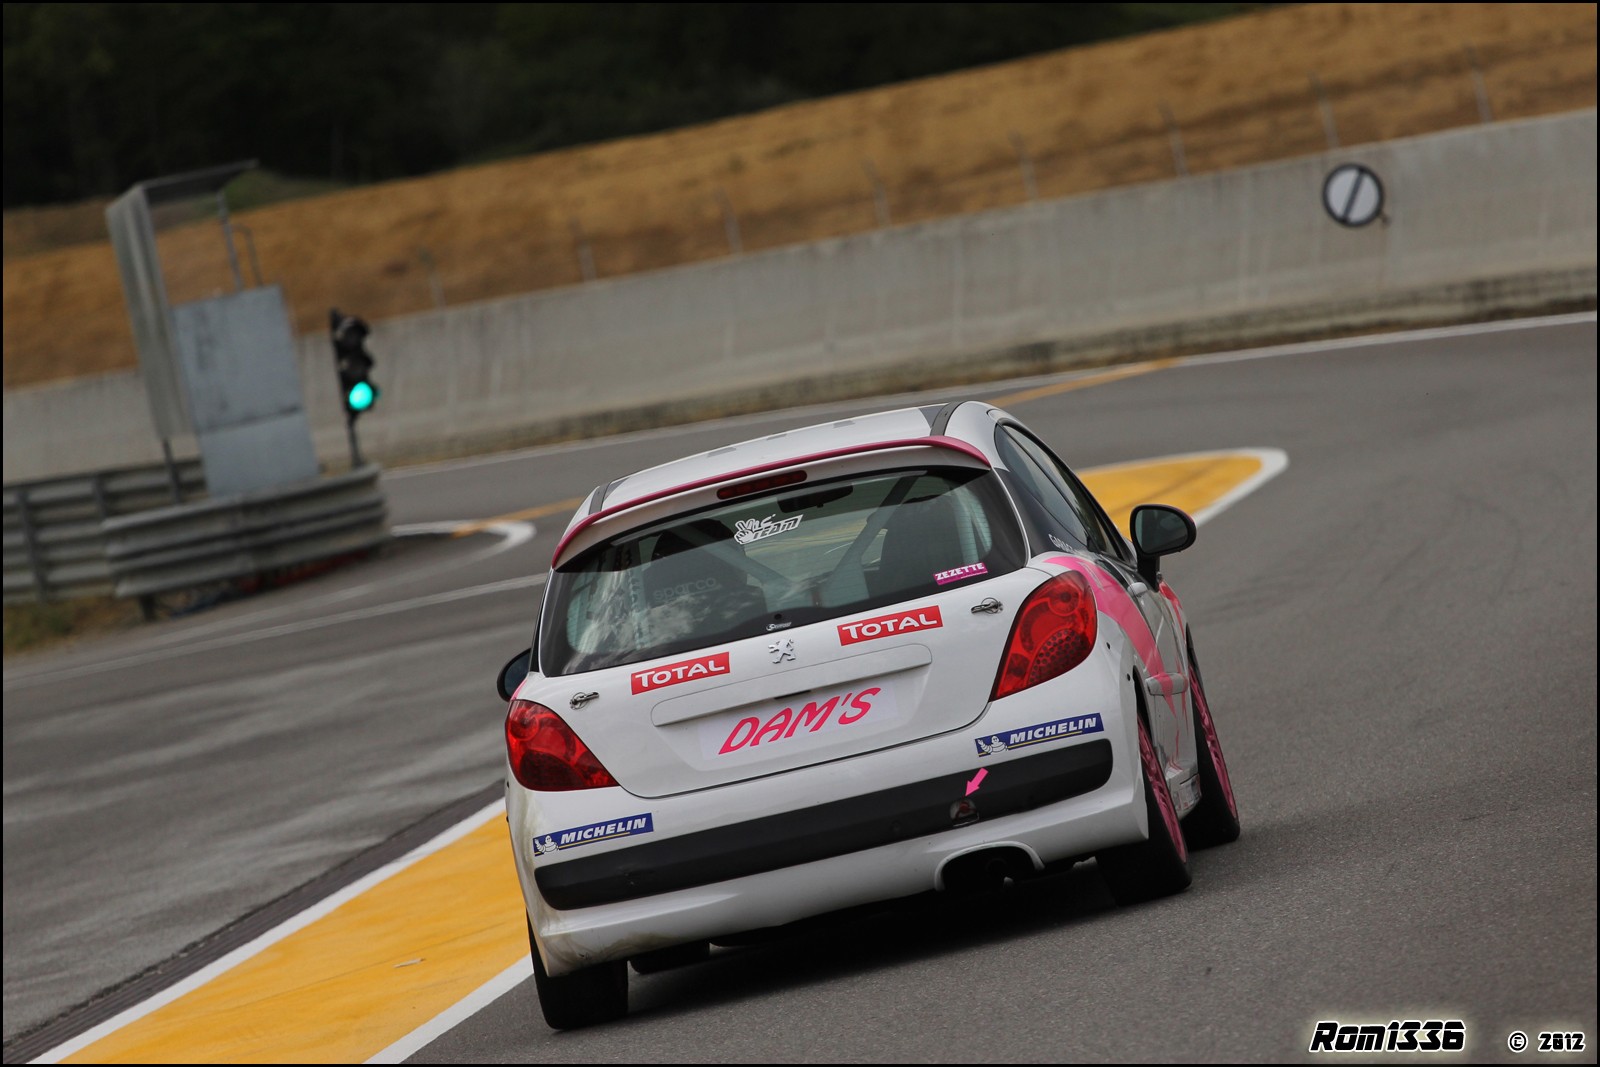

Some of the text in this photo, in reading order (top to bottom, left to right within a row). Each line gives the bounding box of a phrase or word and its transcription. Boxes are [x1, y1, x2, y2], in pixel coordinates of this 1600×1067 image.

[935, 562, 985, 581] ZEZETTE
[842, 612, 938, 639] TOTAL
[635, 659, 725, 688] TOTAL
[718, 687, 881, 755] DAM'S
[1009, 717, 1097, 744] MICHELIN
[560, 817, 647, 844] MICHELIN
